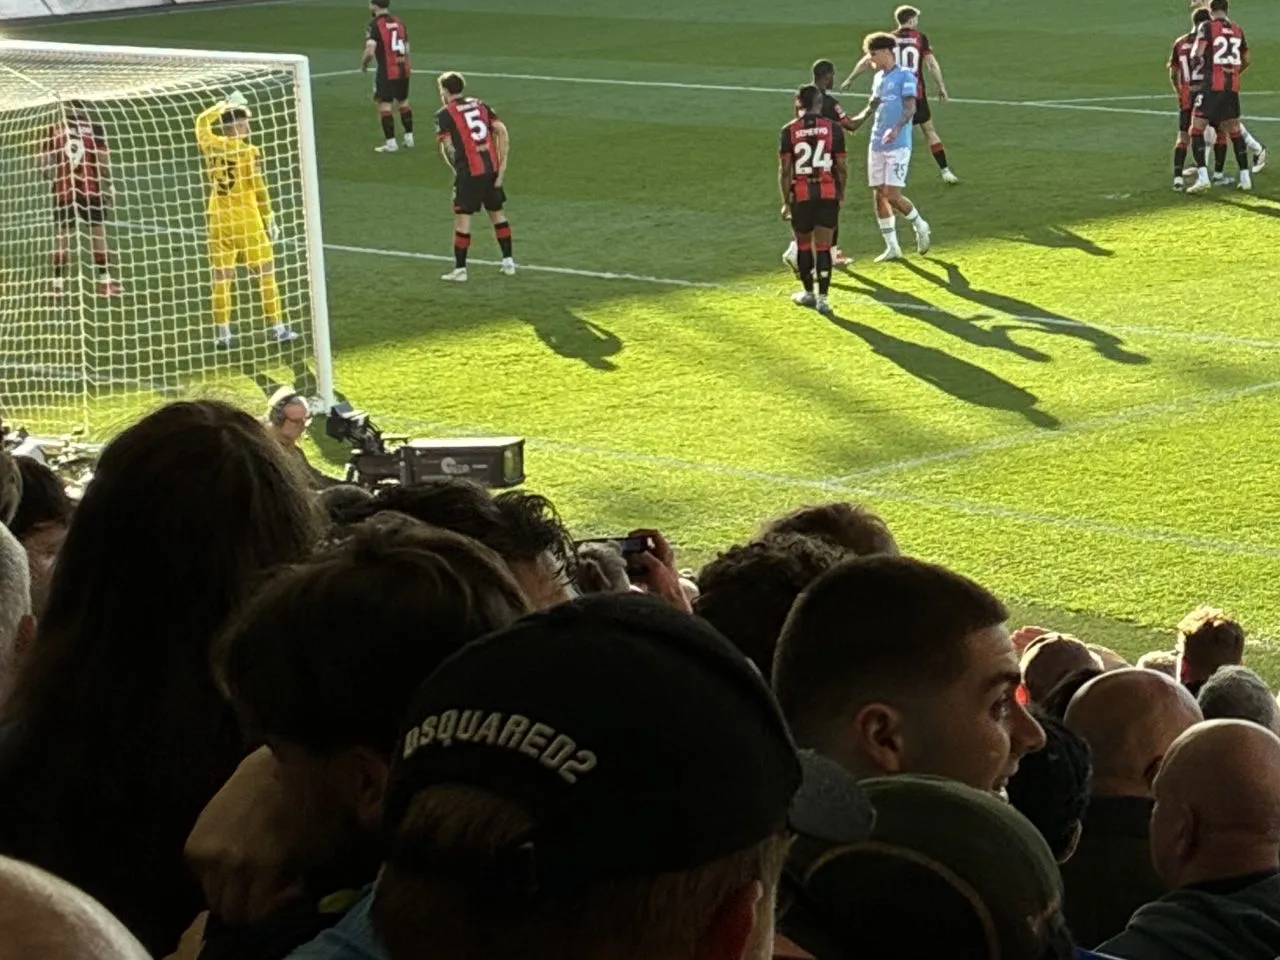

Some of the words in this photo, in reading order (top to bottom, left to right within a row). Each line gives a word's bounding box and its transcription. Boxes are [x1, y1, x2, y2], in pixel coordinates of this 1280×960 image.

[391, 30, 406, 55] 4
[1212, 35, 1242, 65] 23
[893, 45, 920, 73] 10
[464, 109, 489, 141] 5
[794, 140, 833, 175] 24
[403, 709, 597, 784] DSQUARED2
